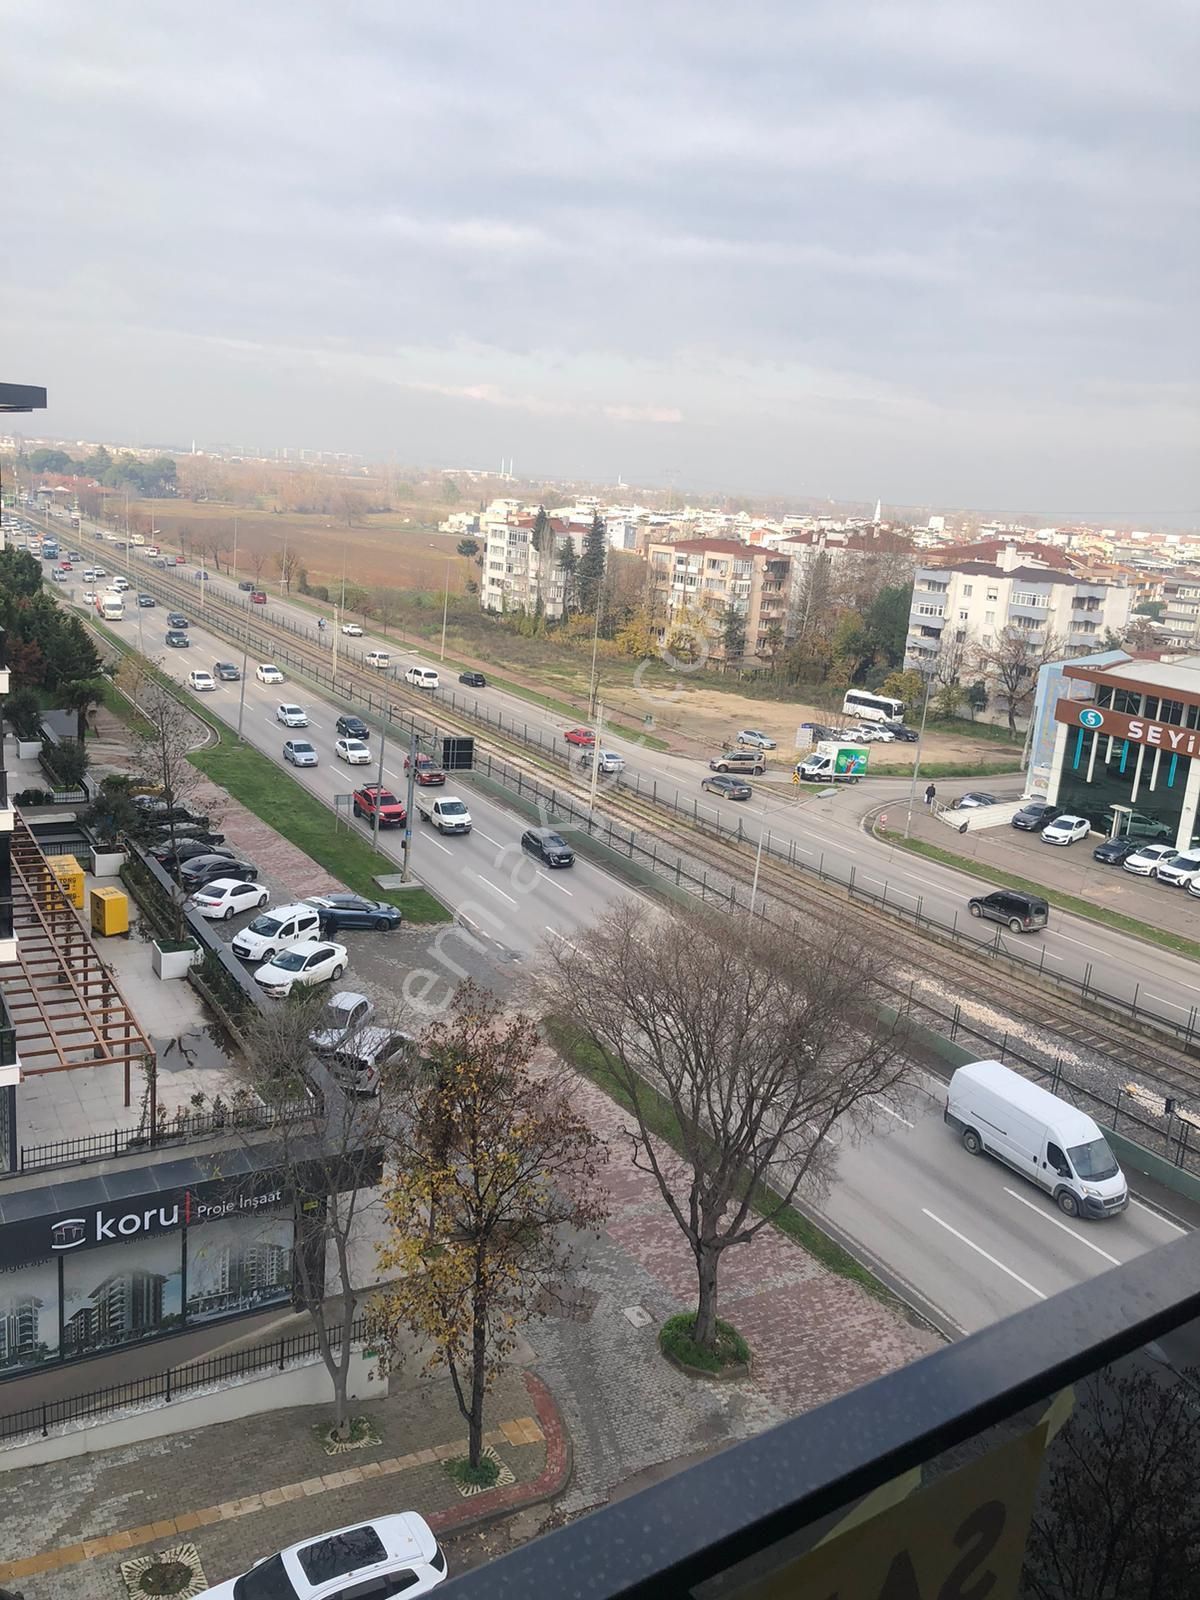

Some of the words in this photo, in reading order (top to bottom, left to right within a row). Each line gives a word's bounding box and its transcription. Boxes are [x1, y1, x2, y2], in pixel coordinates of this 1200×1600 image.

[1127, 720, 1200, 754] SEYİ
[197, 1201, 235, 1218] Proje
[239, 1190, 282, 1209] İnşaat
[95, 1204, 180, 1241] koru
